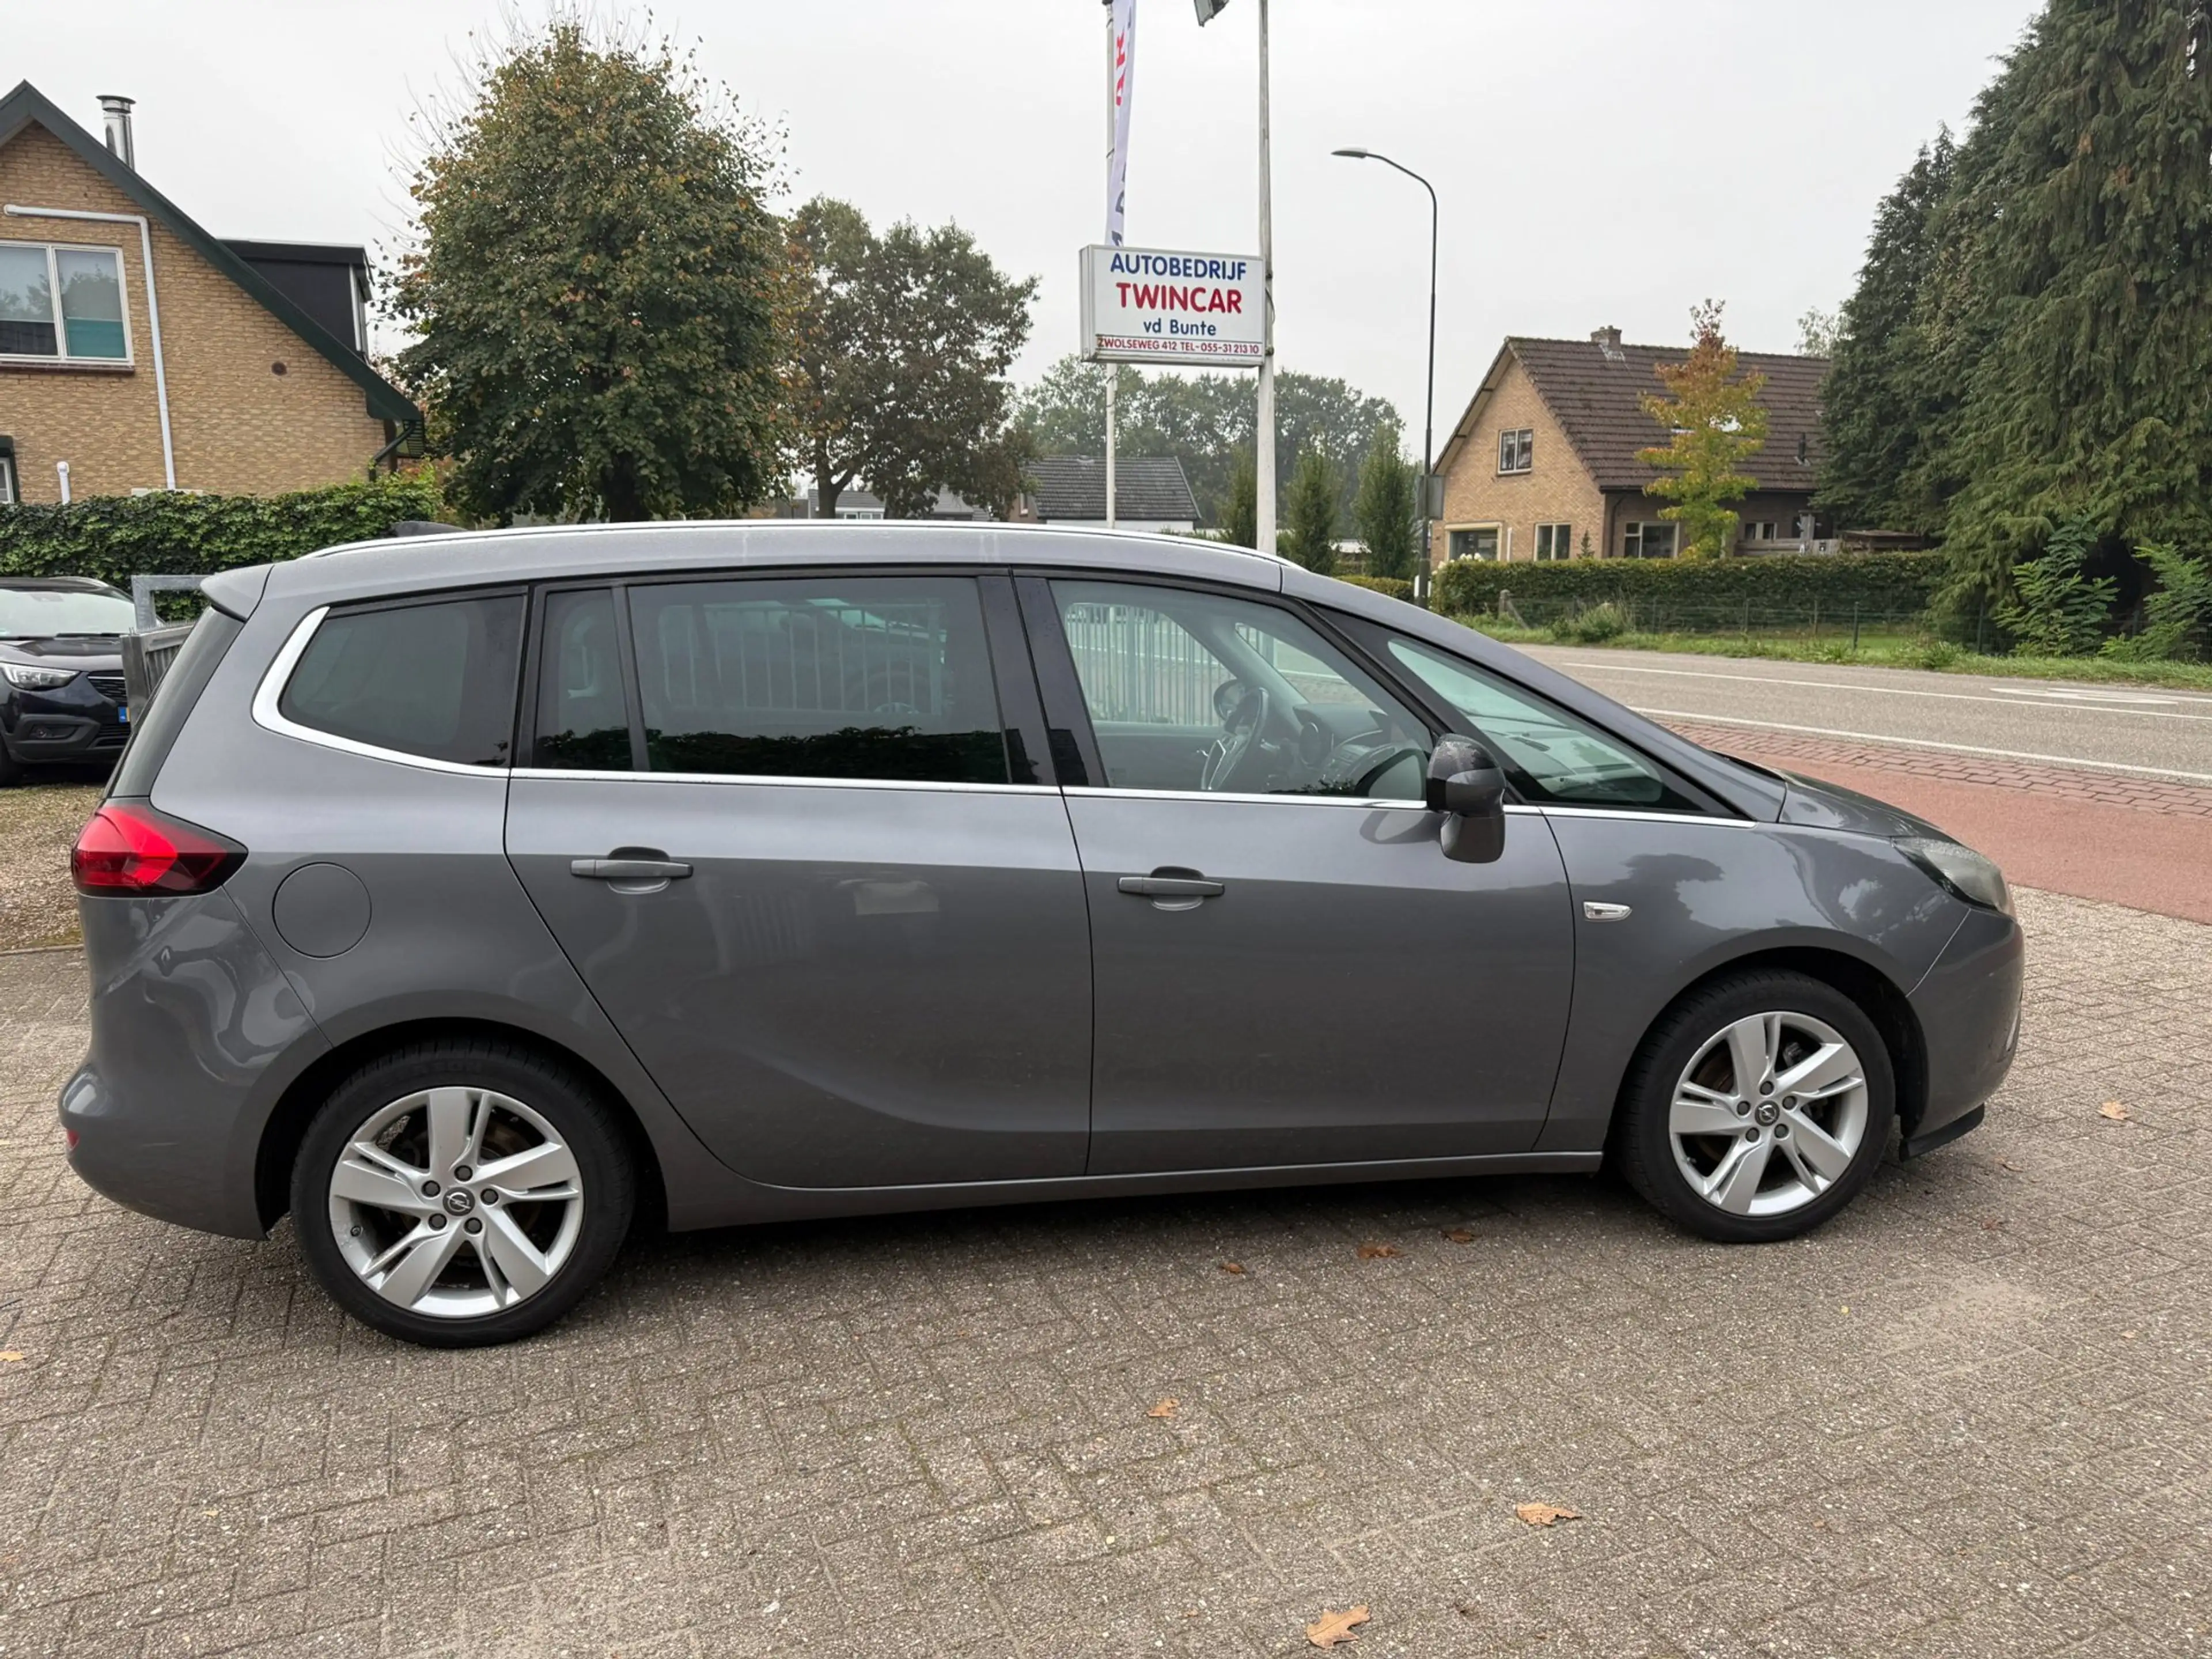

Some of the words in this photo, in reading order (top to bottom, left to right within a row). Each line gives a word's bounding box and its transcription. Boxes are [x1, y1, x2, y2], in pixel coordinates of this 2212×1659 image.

[1110, 253, 1247, 281] AUTOBEDRIJF
[1116, 282, 1242, 314] TWINCAR
[1143, 317, 1161, 333] vd
[1170, 319, 1217, 336] Bunte
[1097, 337, 1160, 350] ZWOLSEWEG
[1162, 341, 1177, 350] 412
